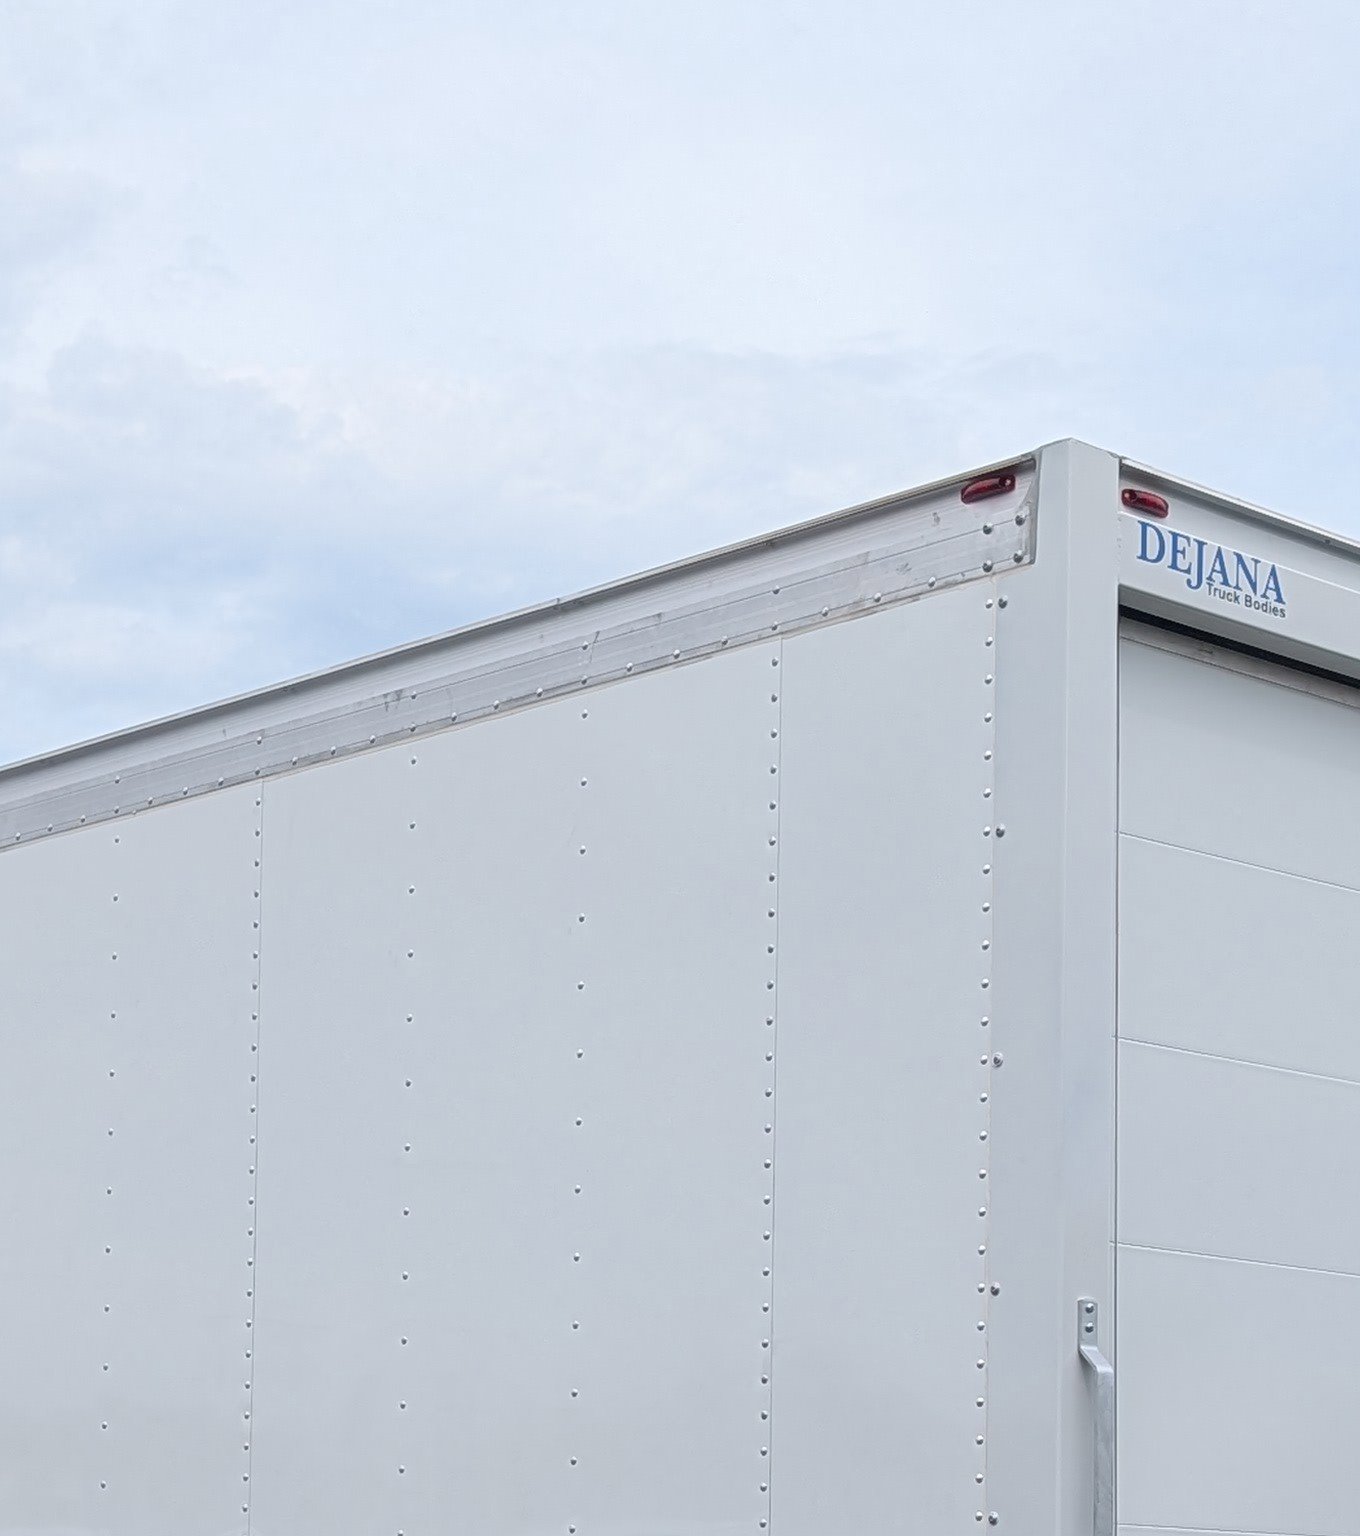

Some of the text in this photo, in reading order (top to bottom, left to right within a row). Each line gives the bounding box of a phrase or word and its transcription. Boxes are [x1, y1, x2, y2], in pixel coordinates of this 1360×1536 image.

[1136, 520, 1286, 605] DEJANA
[1205, 581, 1286, 618] Truck Bodies
